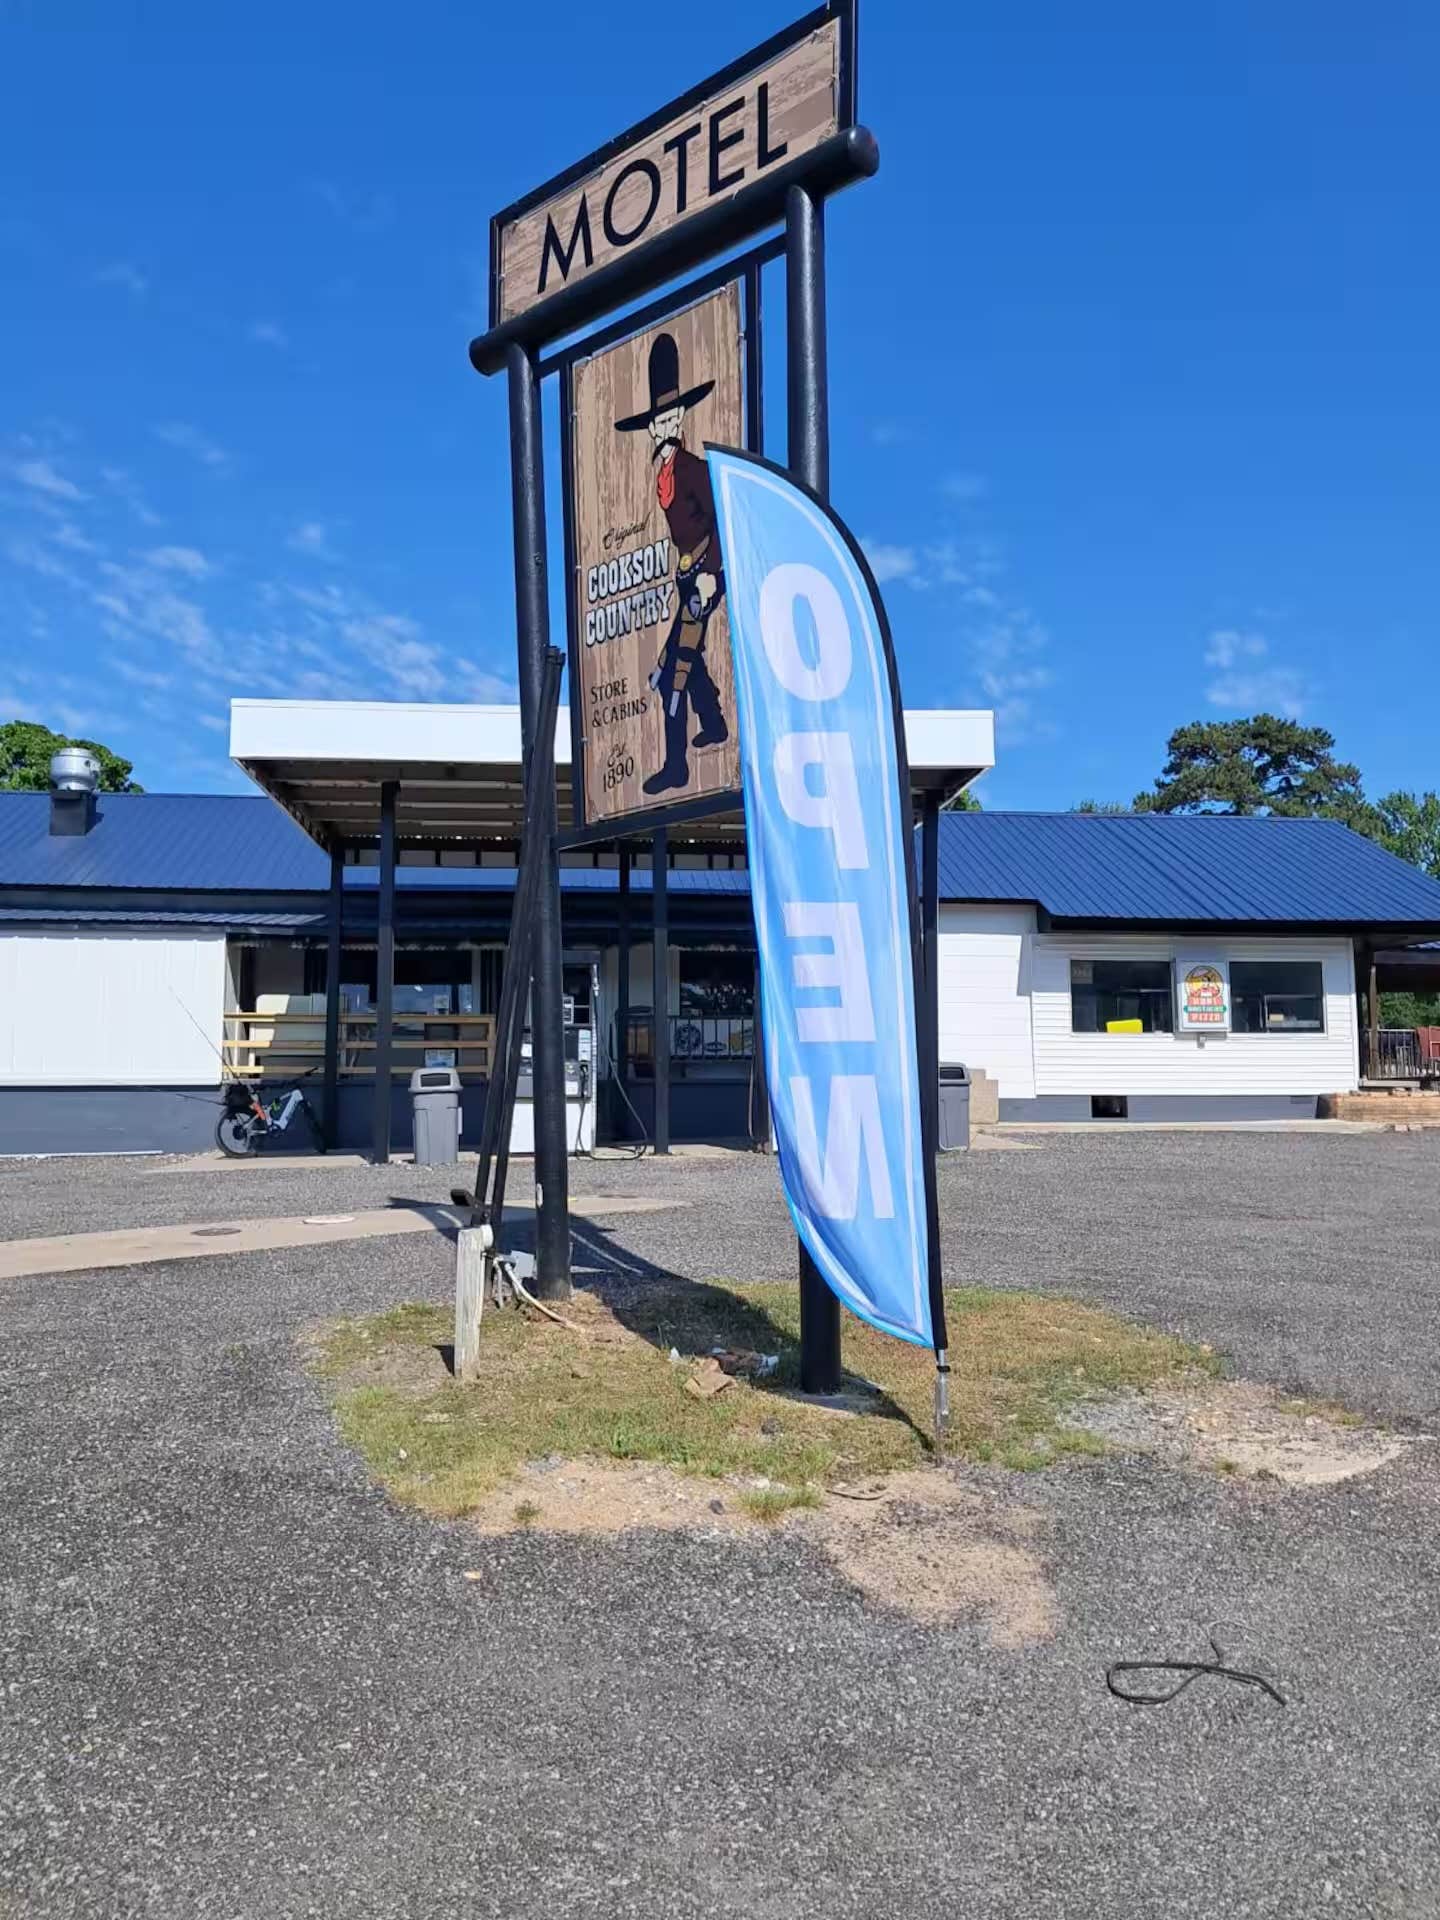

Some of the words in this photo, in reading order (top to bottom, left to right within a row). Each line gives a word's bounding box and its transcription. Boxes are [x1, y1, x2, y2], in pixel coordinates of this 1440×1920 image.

[537, 81, 788, 295] MOTEL
[587, 536, 671, 604] COOKSON
[585, 580, 675, 648] COUNTRY
[590, 677, 629, 705] STORE
[603, 756, 634, 793] 1890
